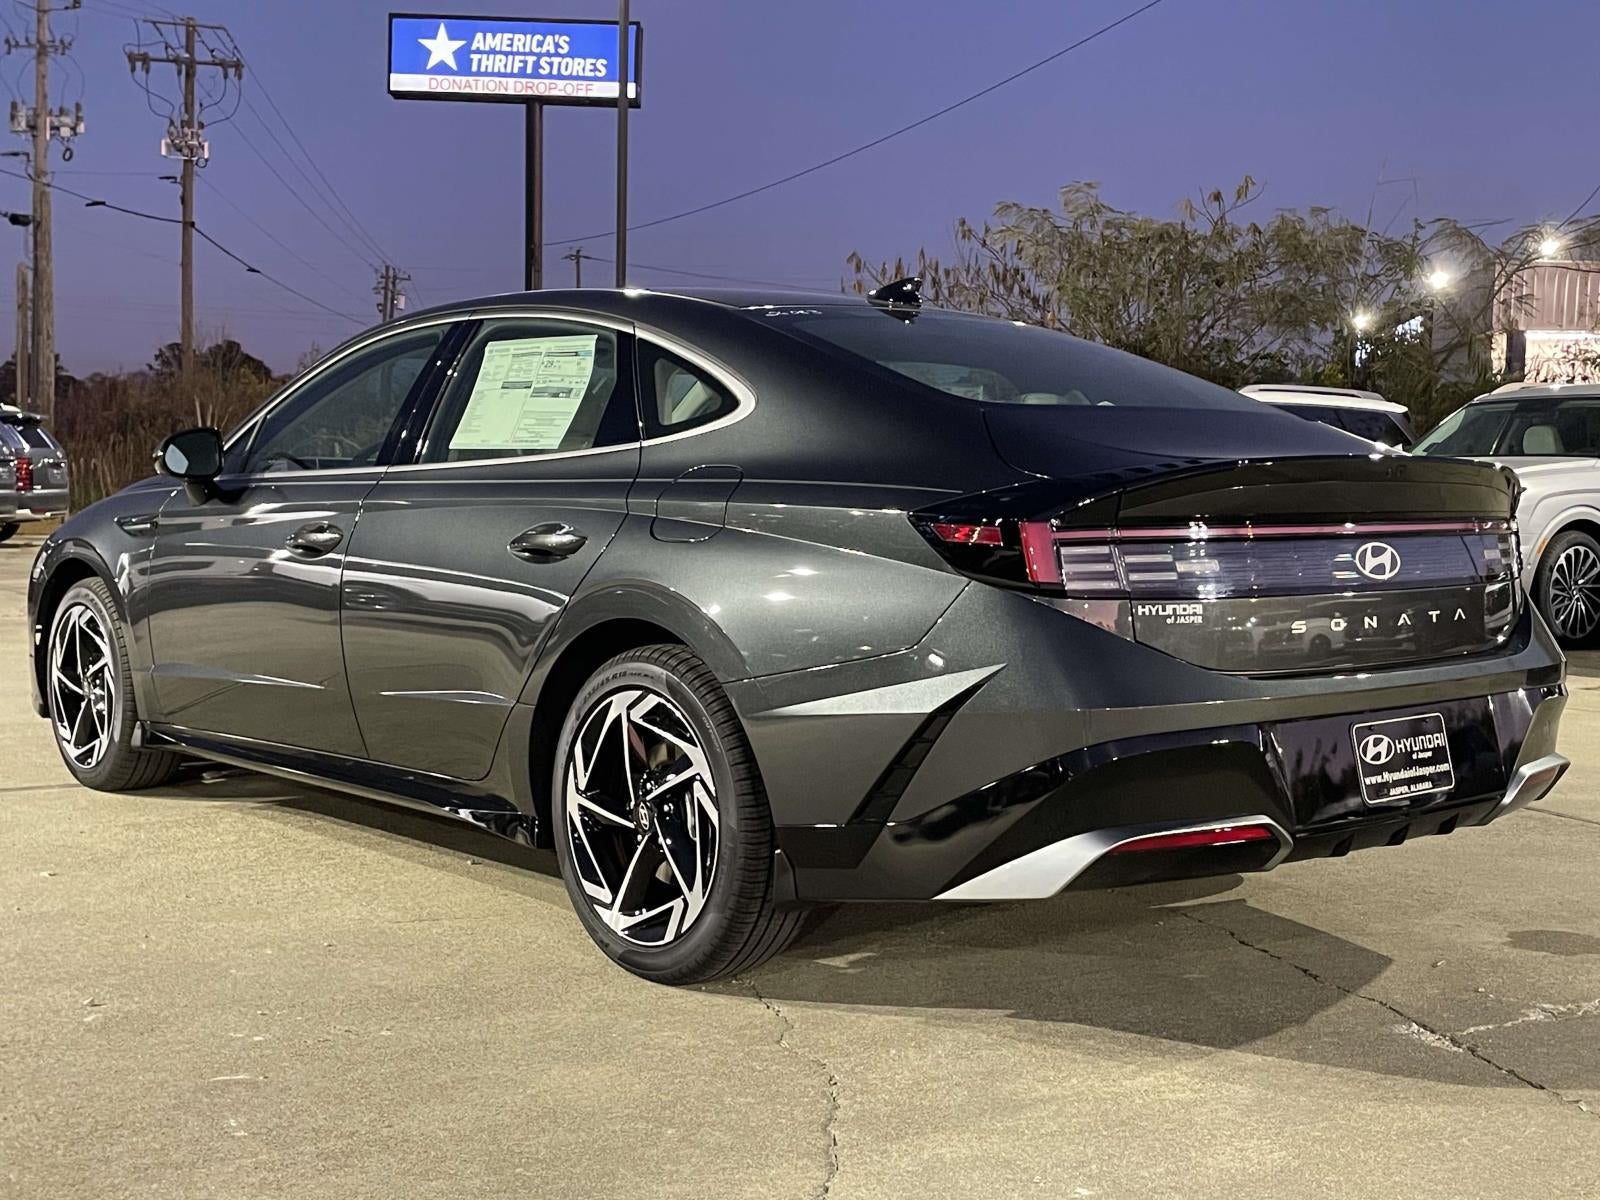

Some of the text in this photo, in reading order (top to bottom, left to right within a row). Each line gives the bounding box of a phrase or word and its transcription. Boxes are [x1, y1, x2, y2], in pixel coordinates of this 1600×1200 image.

[471, 32, 570, 54] AMERICA'S
[470, 54, 608, 78] THRIFT STORES
[428, 77, 593, 96] DONATION DROP-OFF
[1138, 604, 1203, 616] HYUNDAI
[1165, 615, 1203, 624] of JASPER
[1291, 608, 1467, 634] SONATA
[1395, 732, 1446, 754] HYUNDAI
